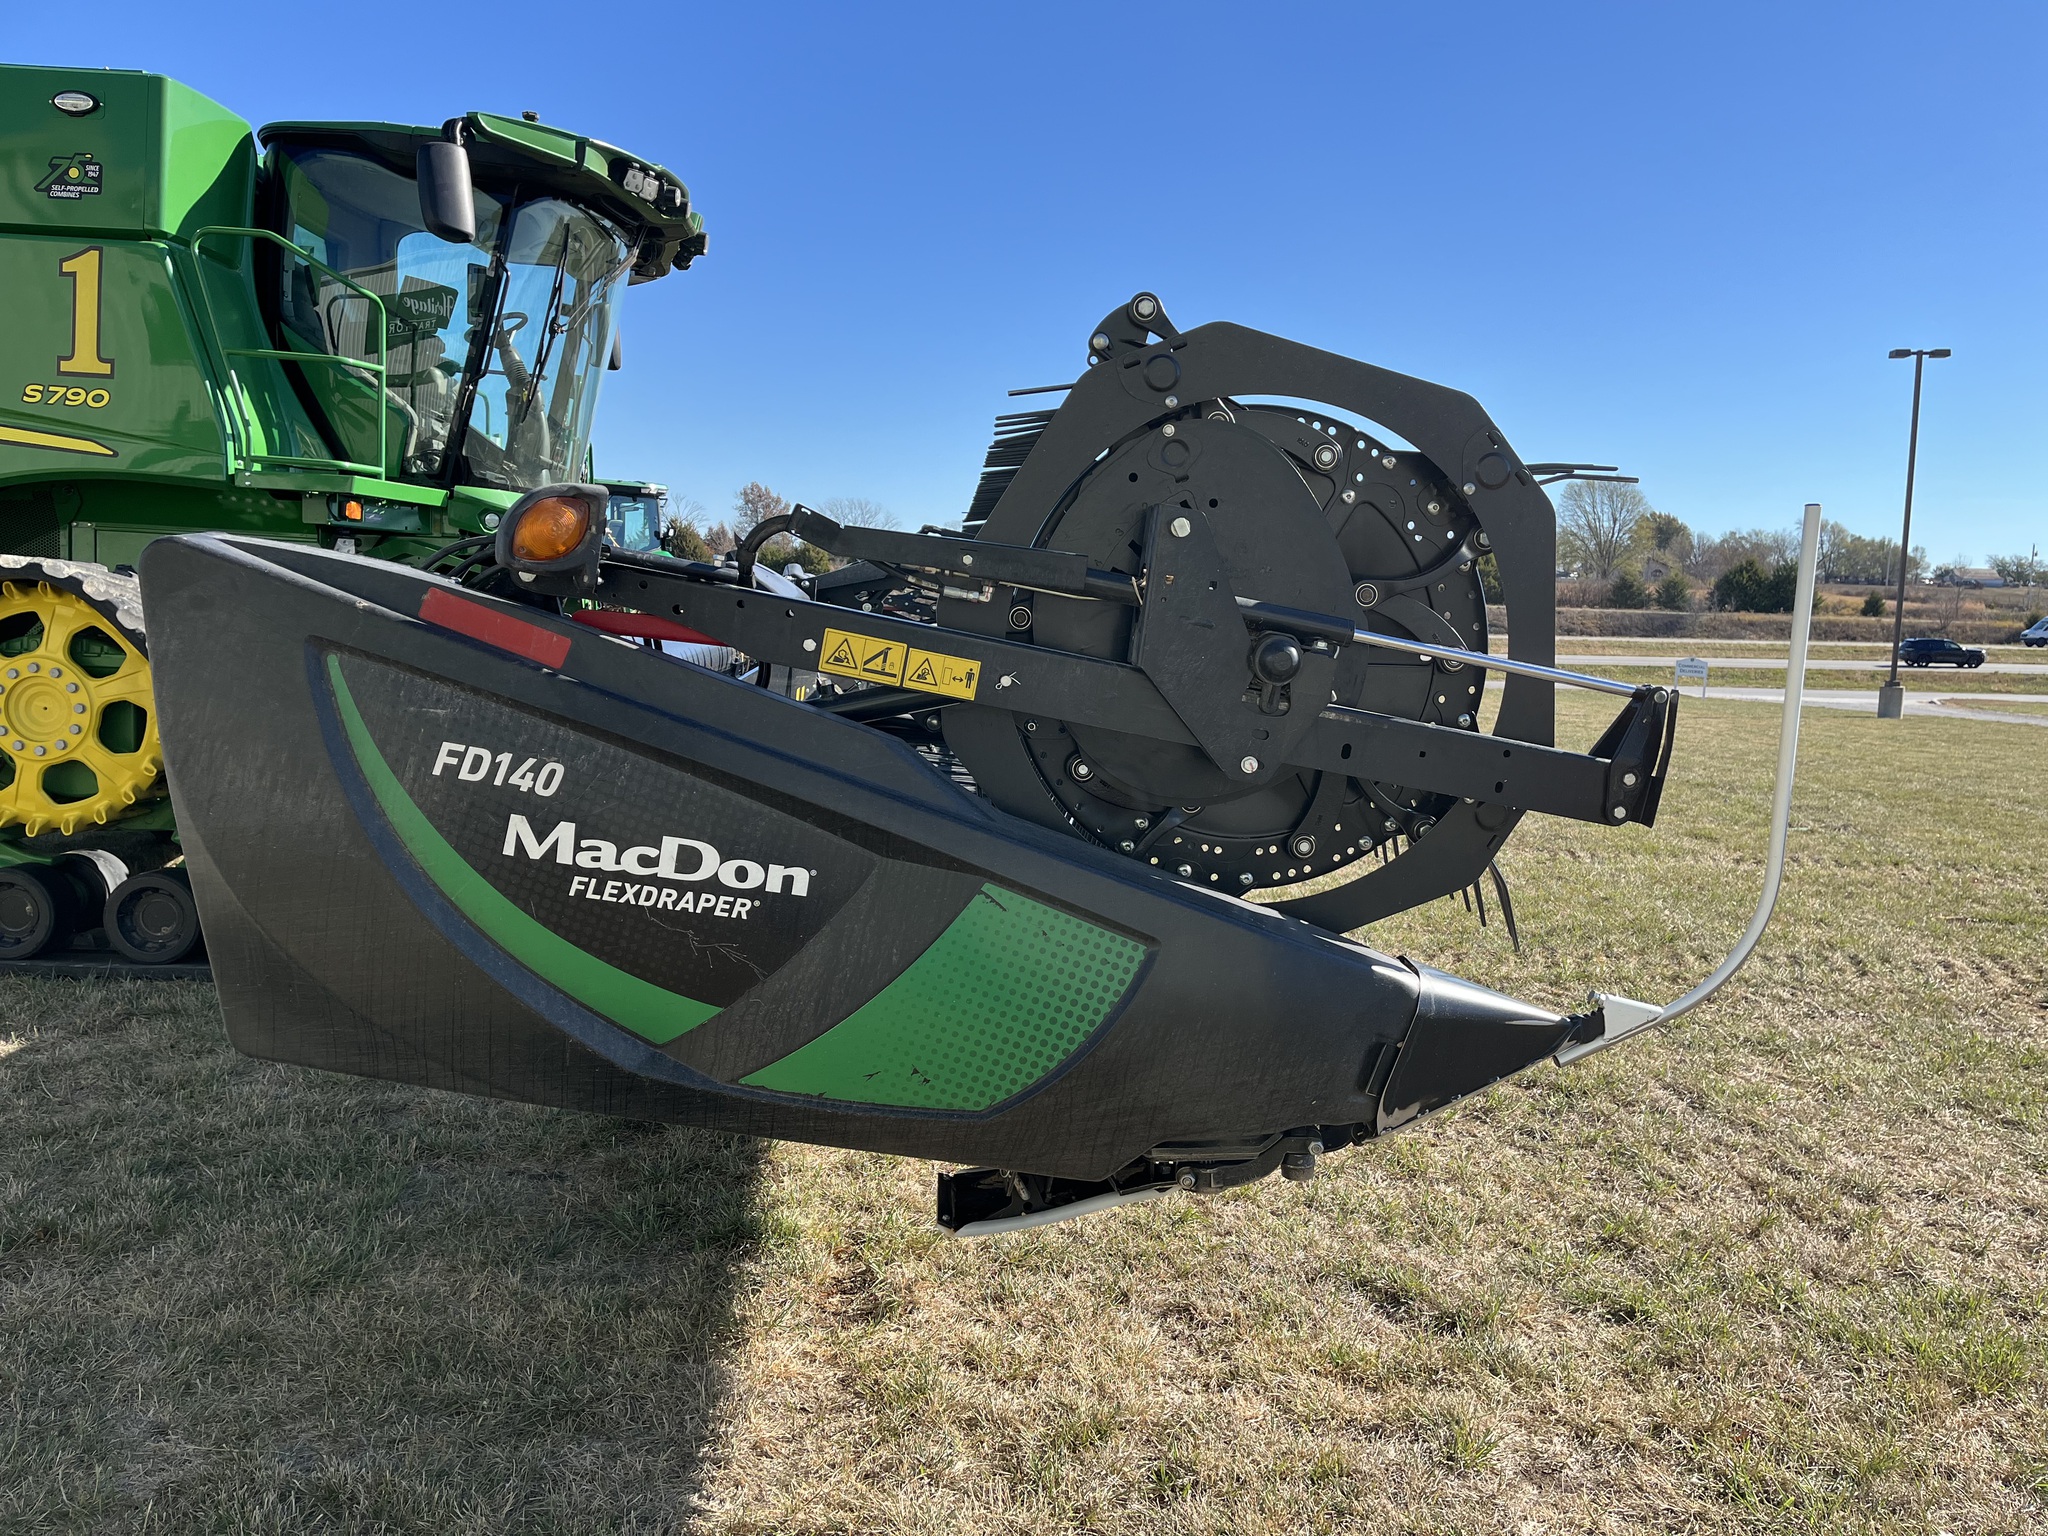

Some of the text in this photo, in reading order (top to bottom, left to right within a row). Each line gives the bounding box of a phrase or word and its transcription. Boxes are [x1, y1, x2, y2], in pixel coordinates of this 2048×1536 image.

[51, 184, 99, 193] SELF-PROPELLED
[57, 246, 114, 378] 1
[432, 741, 565, 797] FD140
